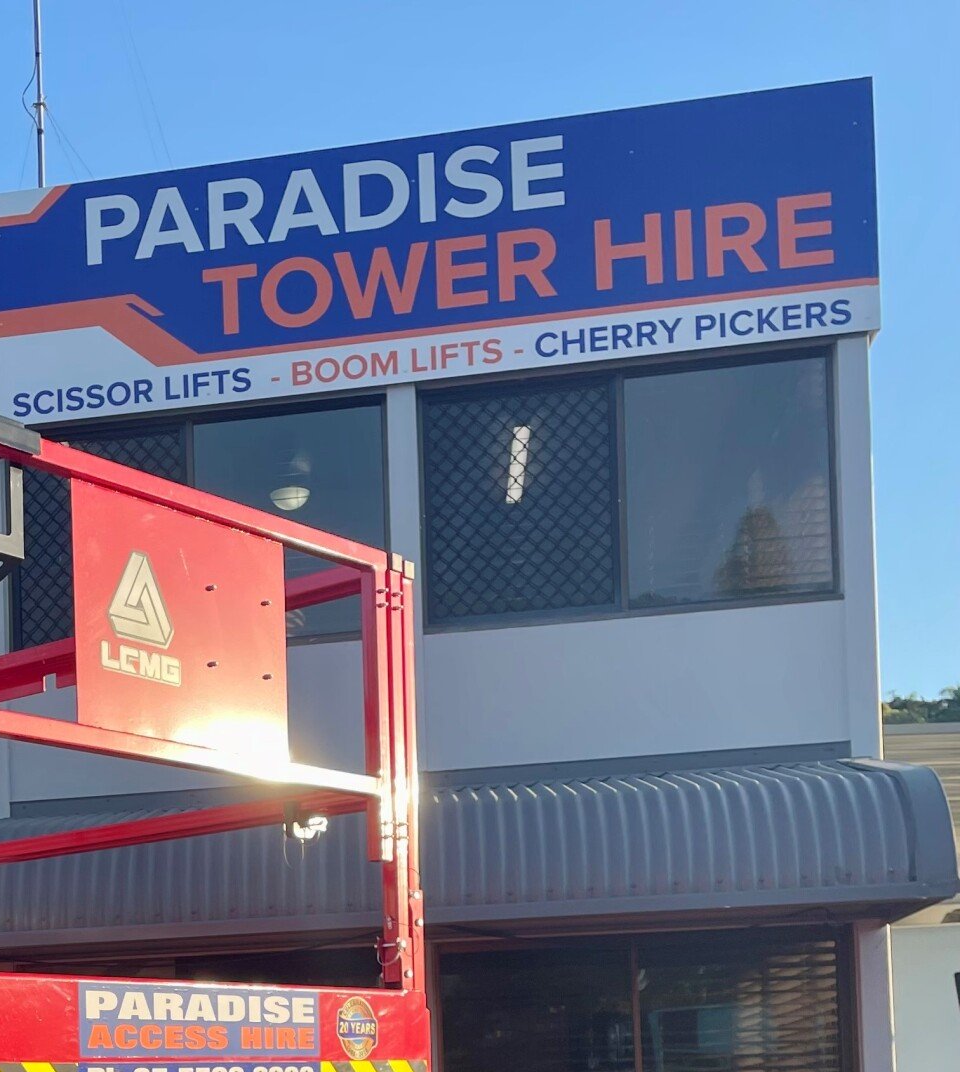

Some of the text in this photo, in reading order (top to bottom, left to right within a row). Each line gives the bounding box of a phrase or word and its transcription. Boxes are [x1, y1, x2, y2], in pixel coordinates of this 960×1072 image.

[85, 135, 565, 266] PARADISE
[203, 192, 834, 336] TOWER HIRE
[13, 380, 153, 418] SCISSOR
[164, 367, 252, 399] LIFTS
[290, 351, 400, 387] BOOM
[410, 338, 503, 376] LIFTS
[534, 317, 683, 359] CHERRY
[694, 299, 852, 341] PICKERS
[101, 640, 182, 687] LCMG
[85, 990, 315, 1024] PARADISE
[339, 1021, 376, 1035] 20 YEARS
[87, 1024, 315, 1050] ACCESS HIRE
